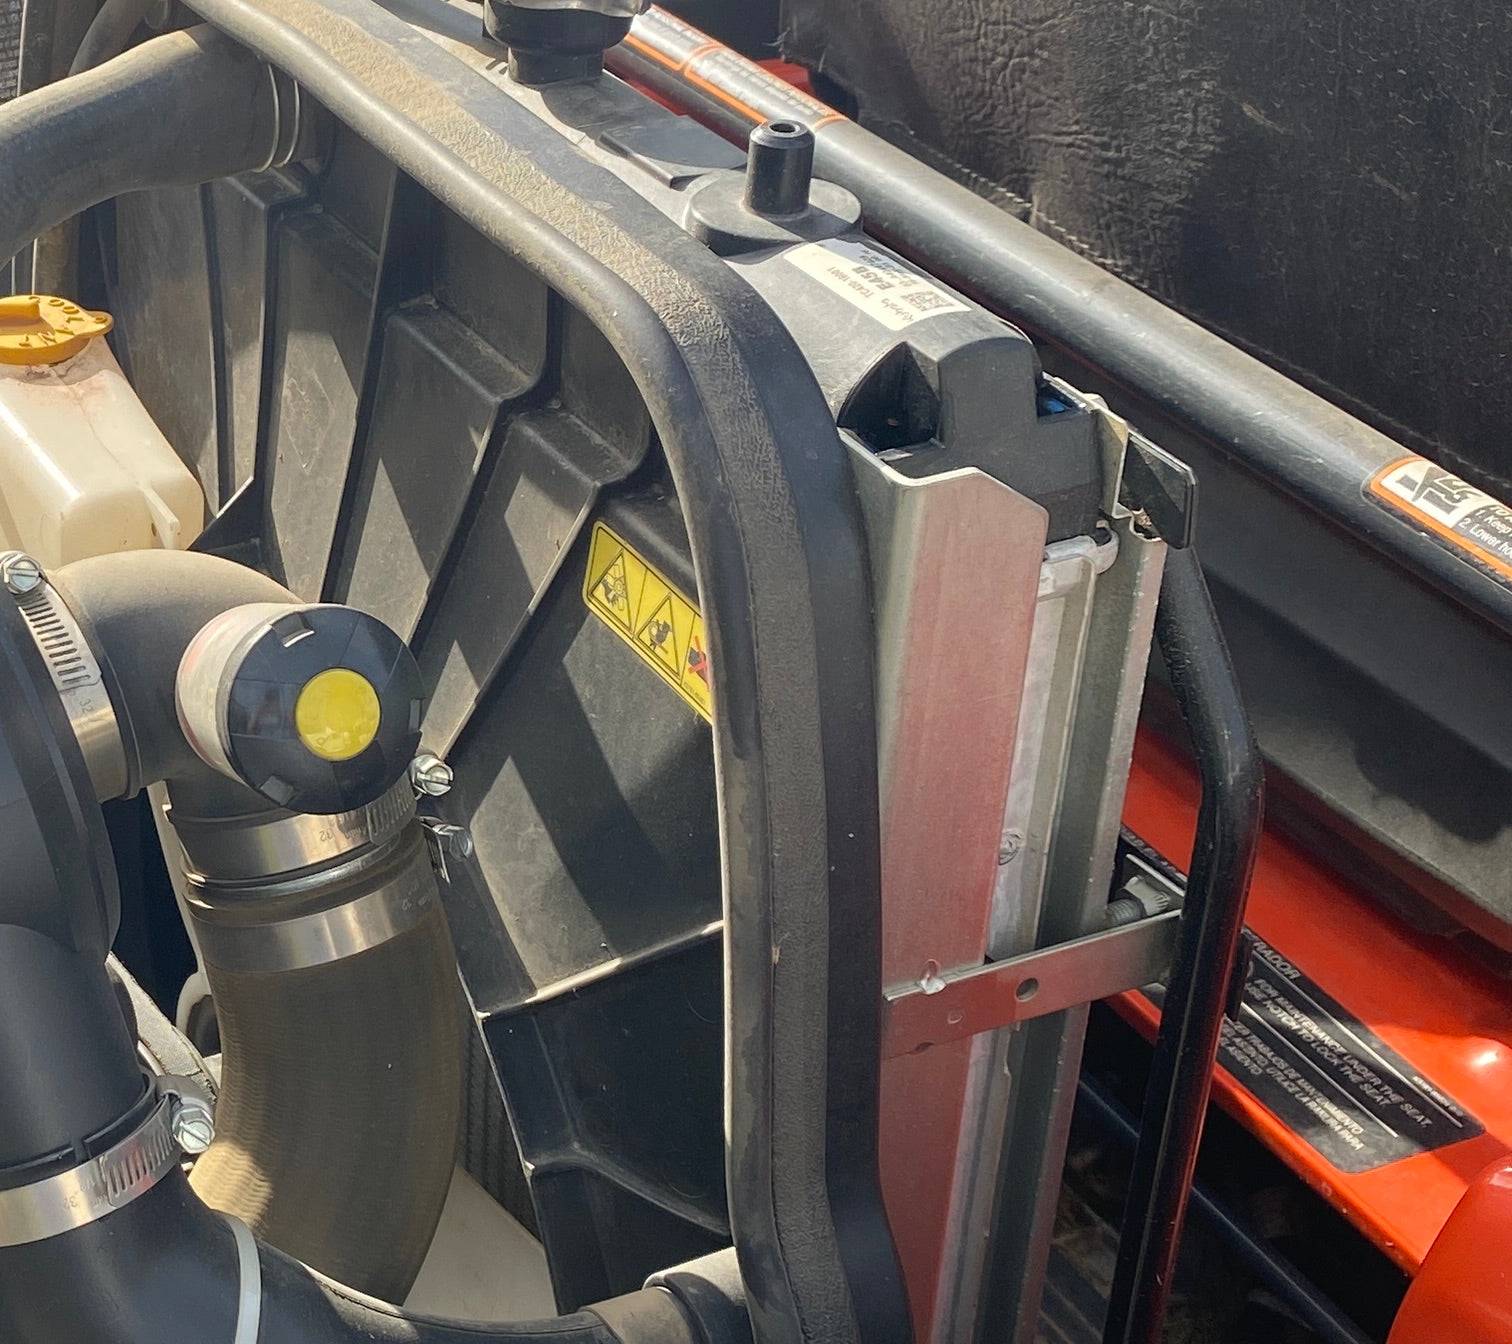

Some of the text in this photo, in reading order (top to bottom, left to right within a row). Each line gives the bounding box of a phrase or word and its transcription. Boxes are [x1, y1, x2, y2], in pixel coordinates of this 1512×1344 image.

[1469, 524, 1501, 548] Lower
[1484, 516, 1511, 534] Keep
[1262, 999, 1299, 1029] NOTCH
[1297, 1029, 1314, 1041] TO
[1310, 1041, 1340, 1063] LOCK
[1340, 1067, 1362, 1082] THE
[1343, 1055, 1382, 1084] UNDER
[1379, 1087, 1403, 1101] THE
